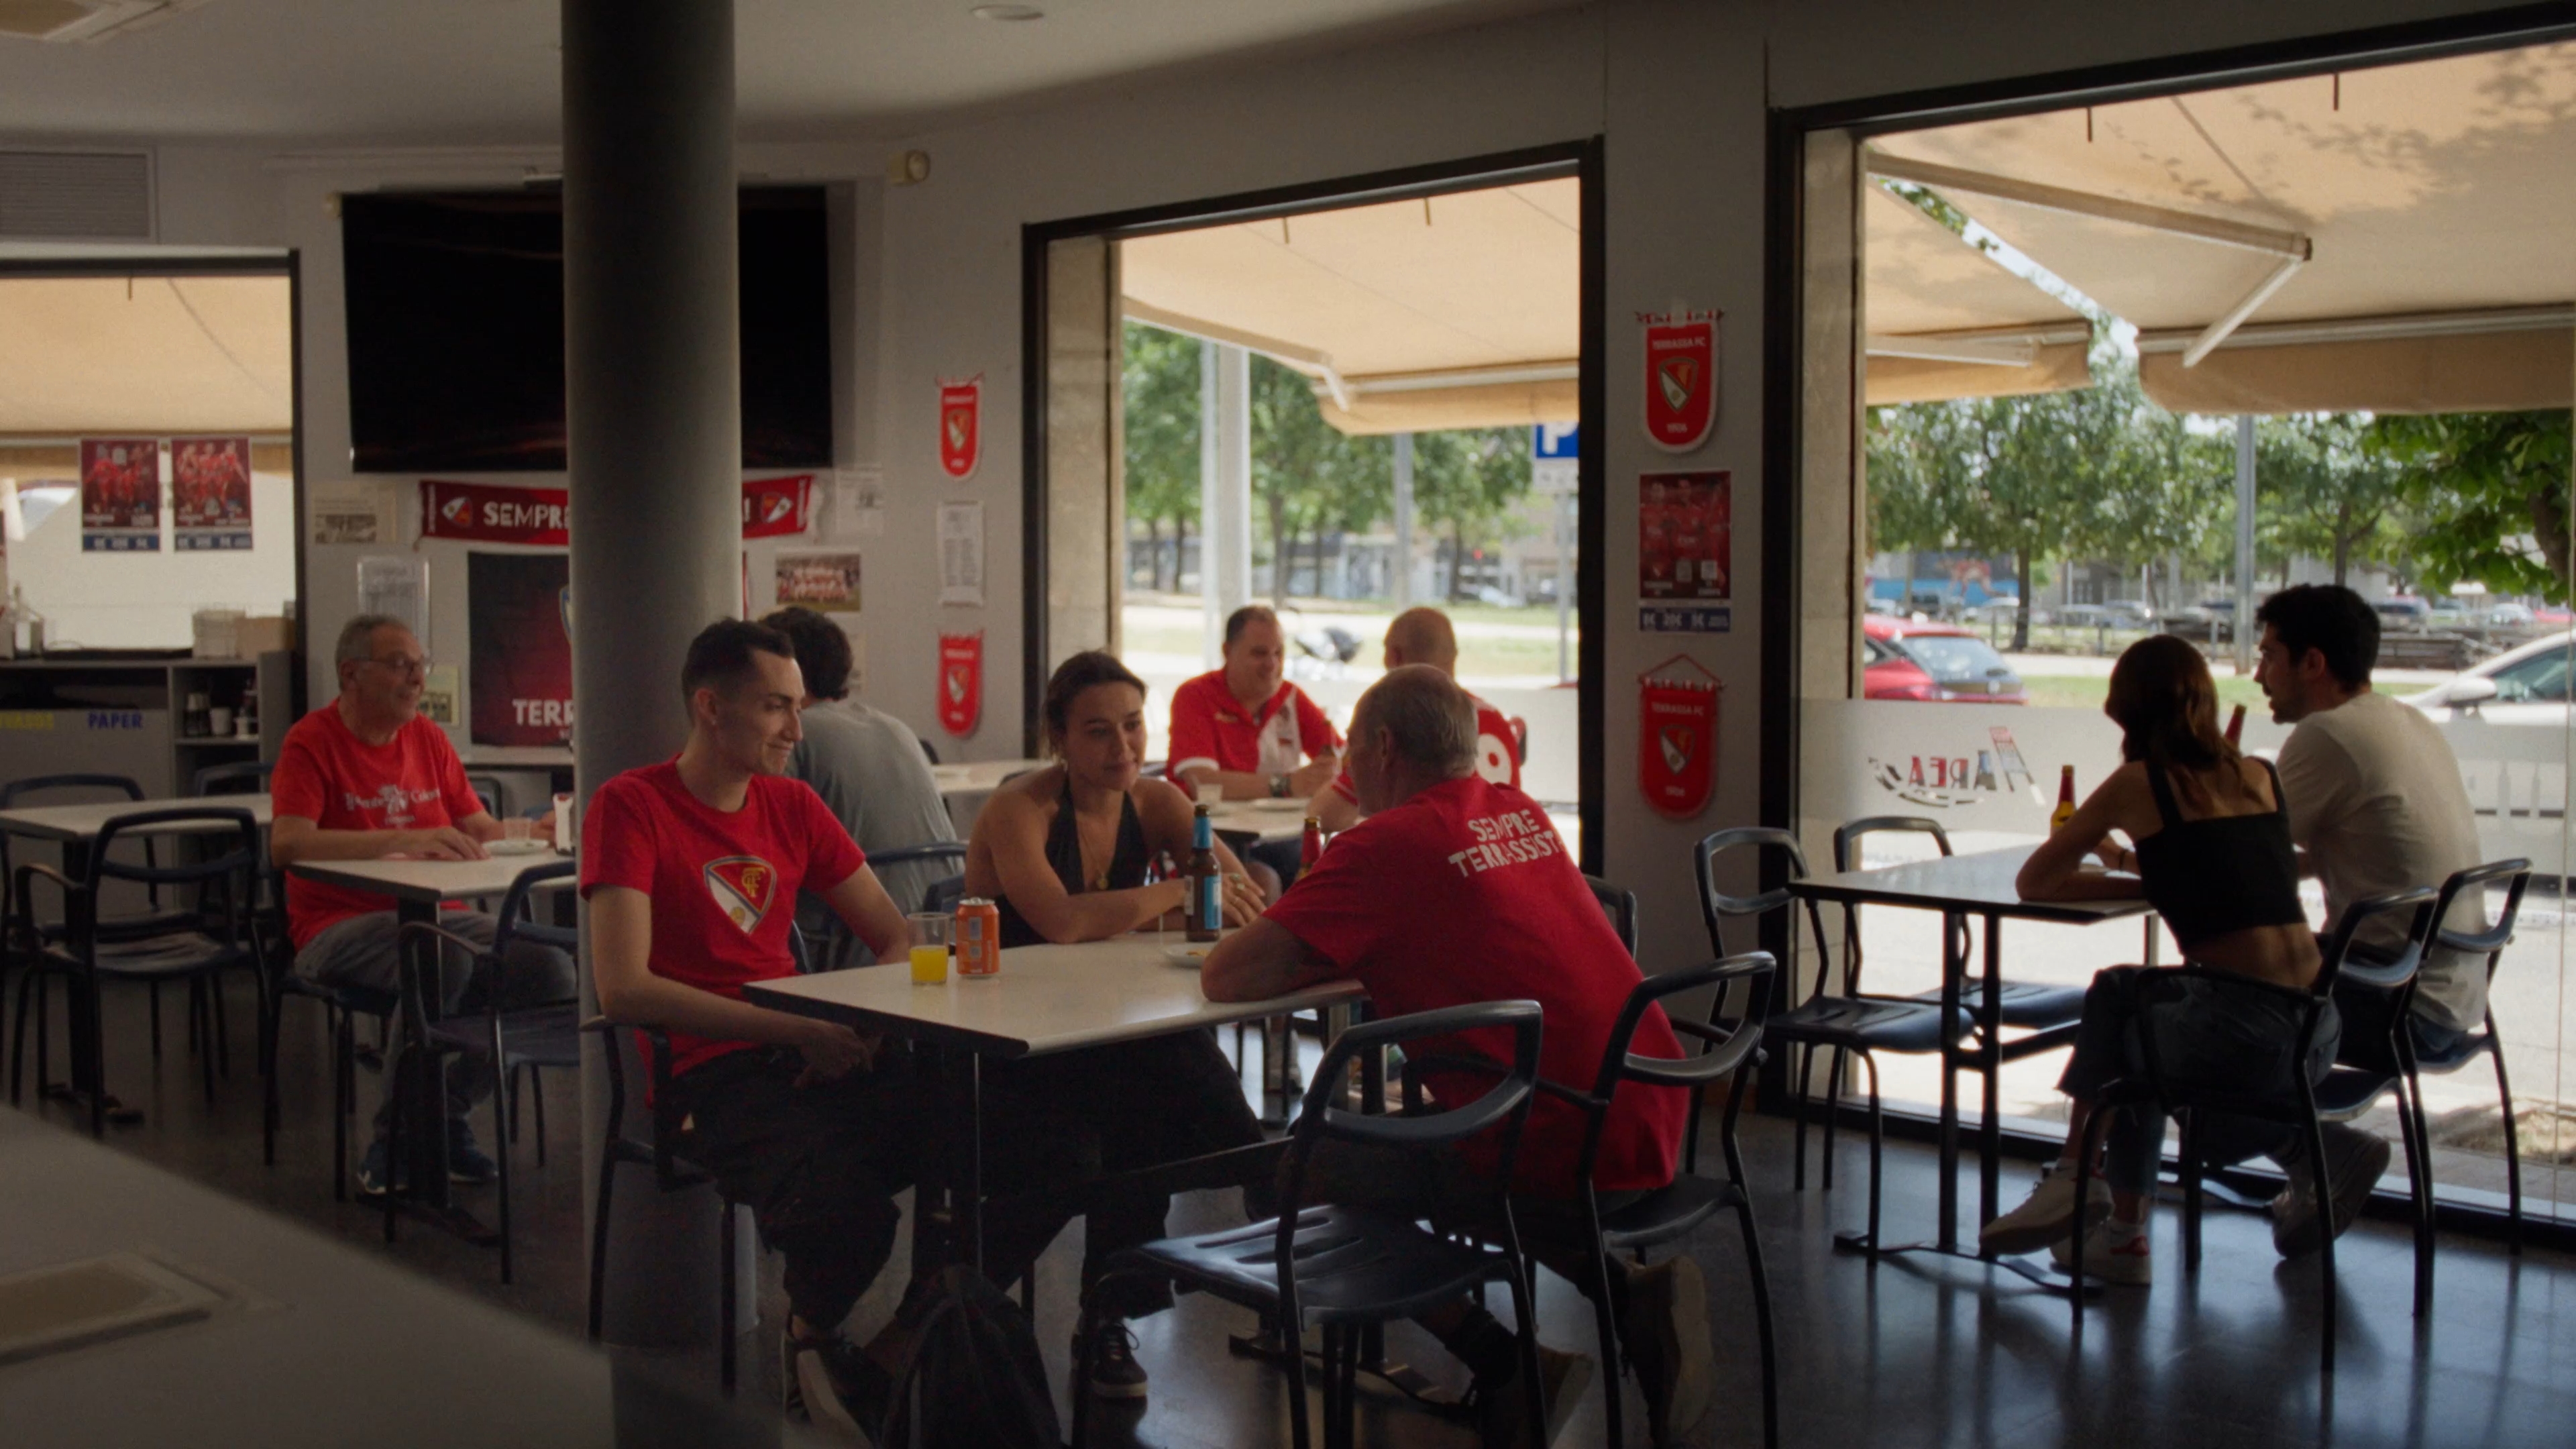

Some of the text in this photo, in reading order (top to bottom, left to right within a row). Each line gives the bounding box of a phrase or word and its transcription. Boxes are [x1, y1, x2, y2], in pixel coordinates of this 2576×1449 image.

[88, 712, 142, 730] PAPER
[1467, 809, 1541, 843] SEMPRE
[1447, 830, 1564, 879] TERRASSIST
